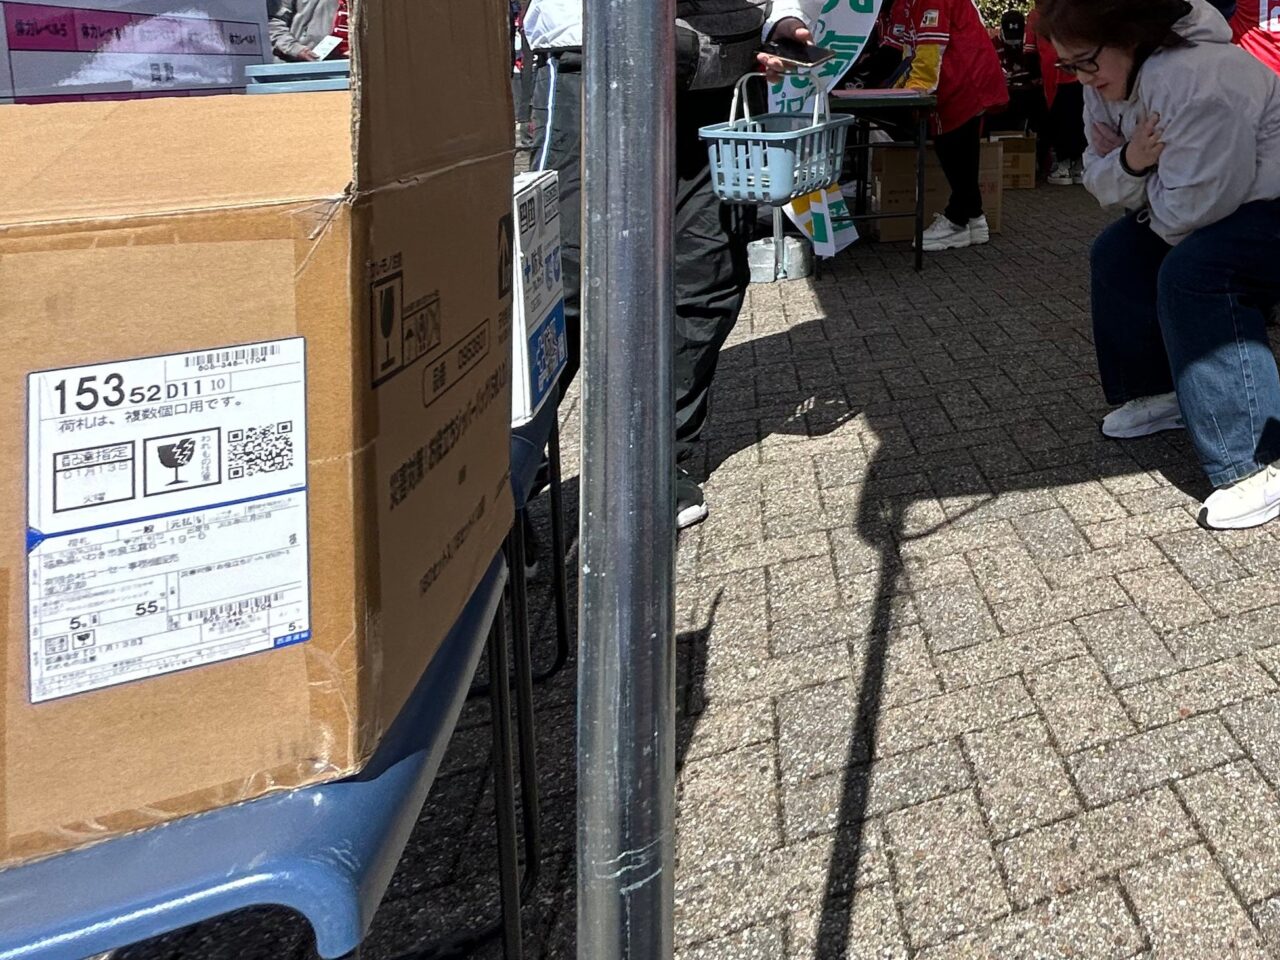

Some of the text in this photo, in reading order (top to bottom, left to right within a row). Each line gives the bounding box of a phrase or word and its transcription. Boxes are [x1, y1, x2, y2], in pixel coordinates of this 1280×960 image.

[54, 372, 162, 415] 153 52
[166, 380, 201, 399] D11
